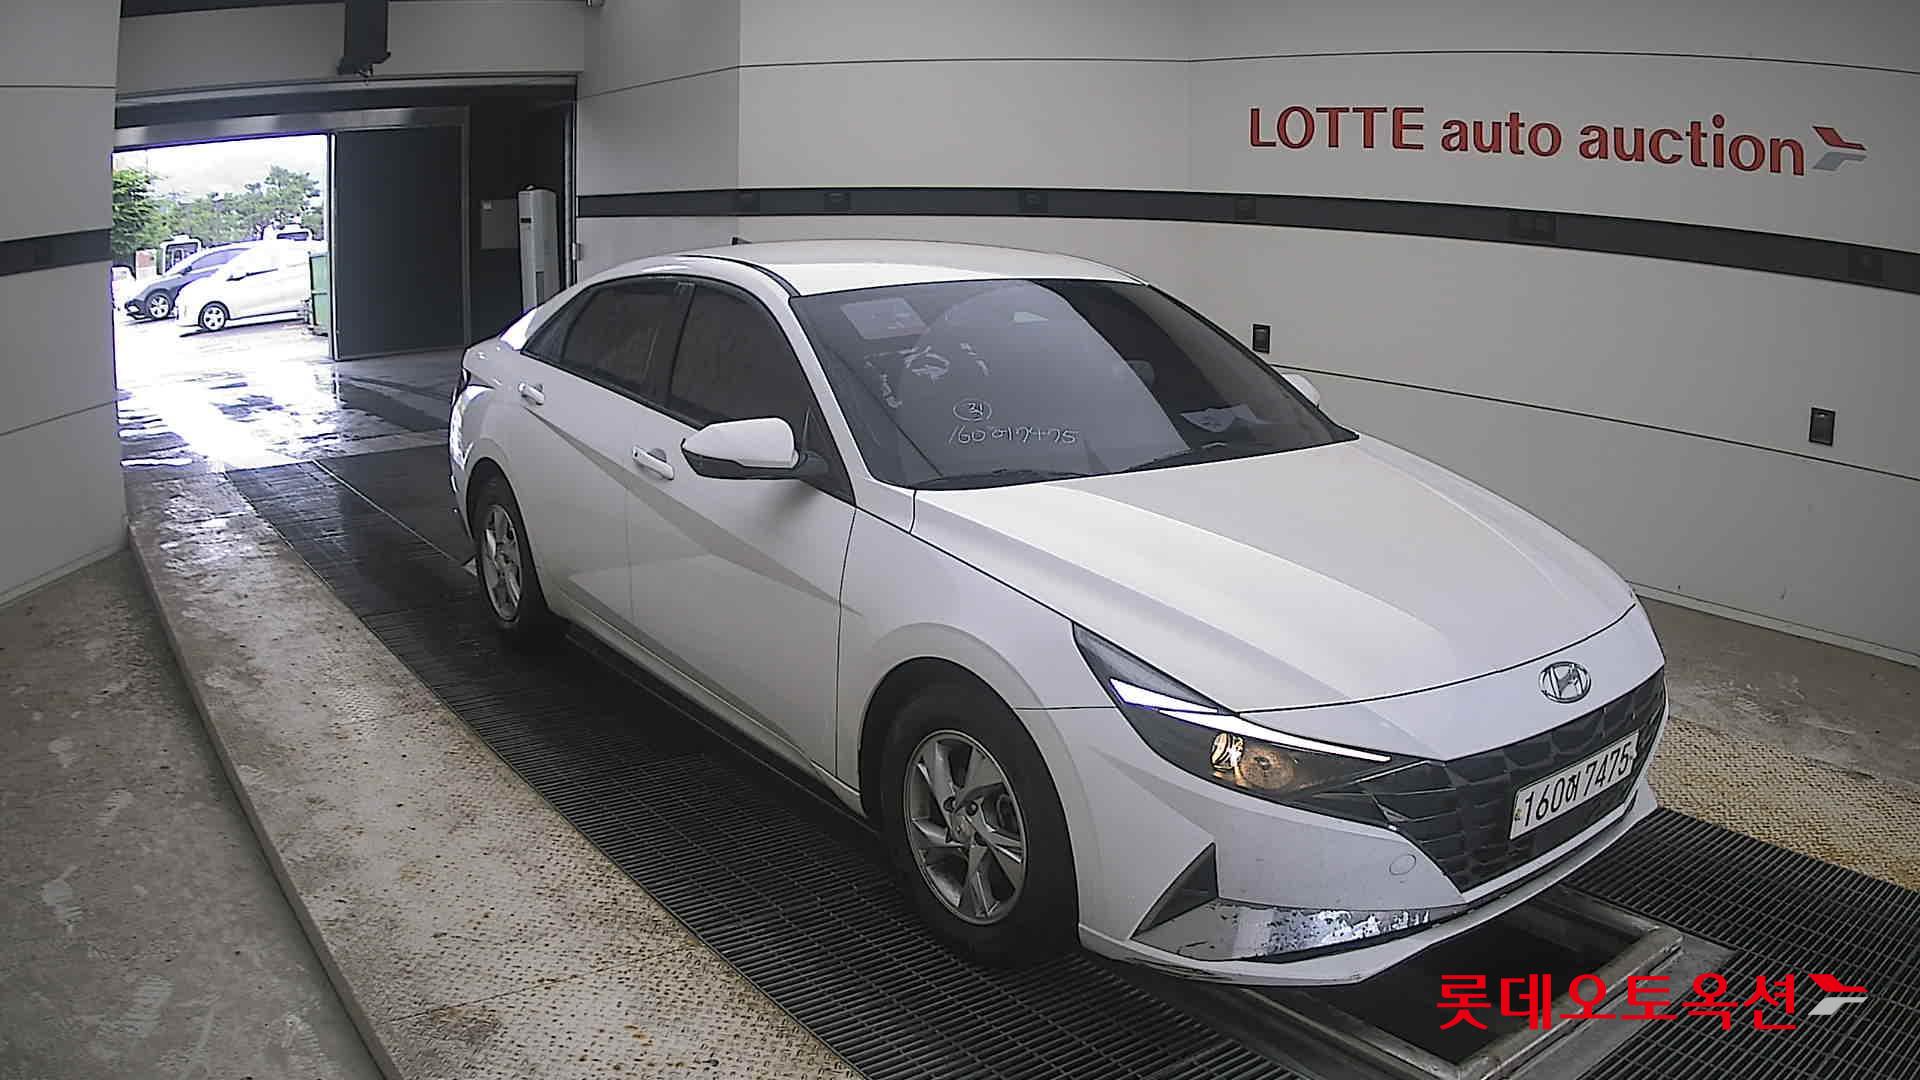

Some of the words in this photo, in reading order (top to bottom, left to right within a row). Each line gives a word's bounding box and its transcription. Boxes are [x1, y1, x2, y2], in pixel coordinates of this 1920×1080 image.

[1249, 106, 1425, 151] LOTTE
[1440, 112, 1562, 157] auto
[1578, 114, 1806, 177] auction
